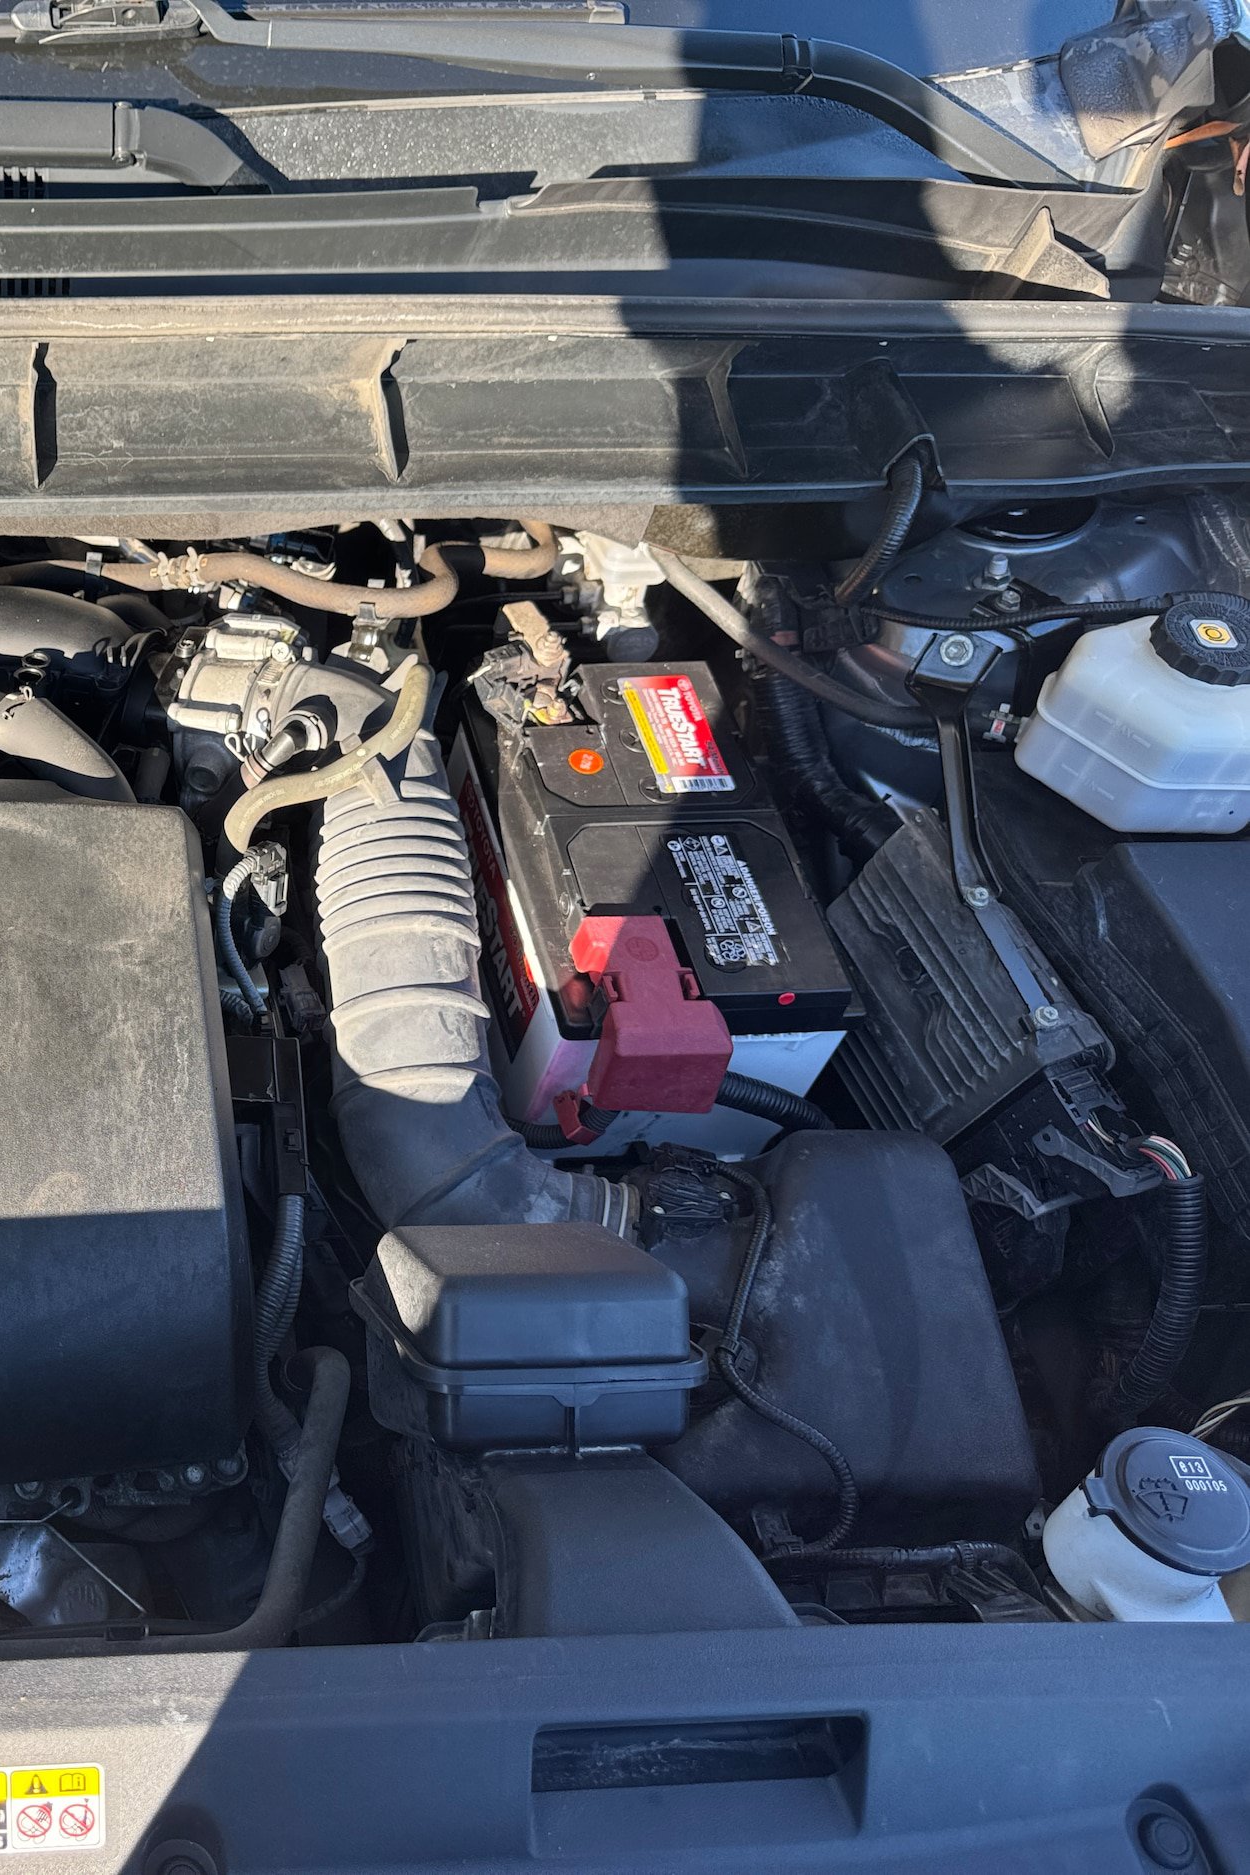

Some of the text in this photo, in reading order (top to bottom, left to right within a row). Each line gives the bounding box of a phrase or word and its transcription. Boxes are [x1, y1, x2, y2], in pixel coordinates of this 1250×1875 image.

[683, 691, 703, 722] TOYOTA
[472, 812, 497, 879] TOYOTA
[1178, 1461, 1204, 1474] e13
[1185, 1480, 1228, 1492] 000105
